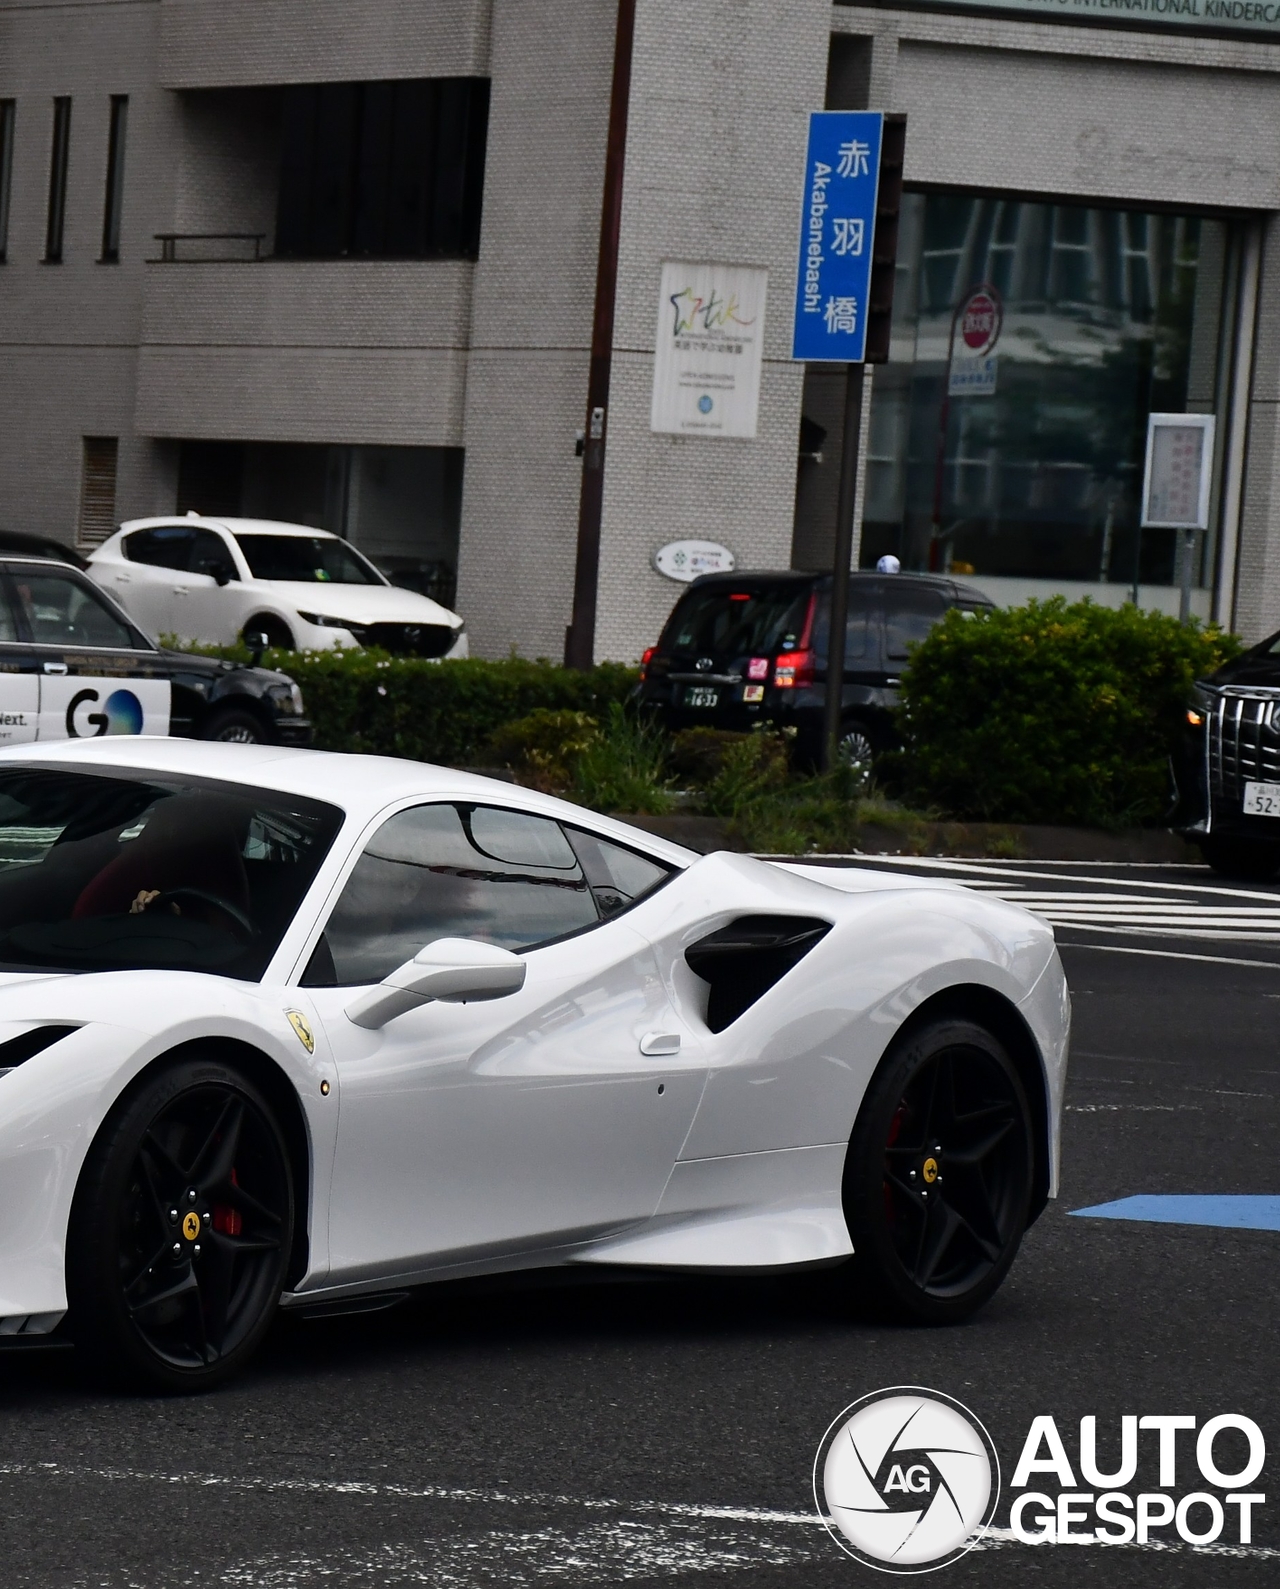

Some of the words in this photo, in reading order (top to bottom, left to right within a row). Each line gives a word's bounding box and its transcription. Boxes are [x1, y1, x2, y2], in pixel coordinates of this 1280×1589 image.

[803, 161, 832, 313] Akabanebashi
[824, 139, 870, 335] 赤羽橋
